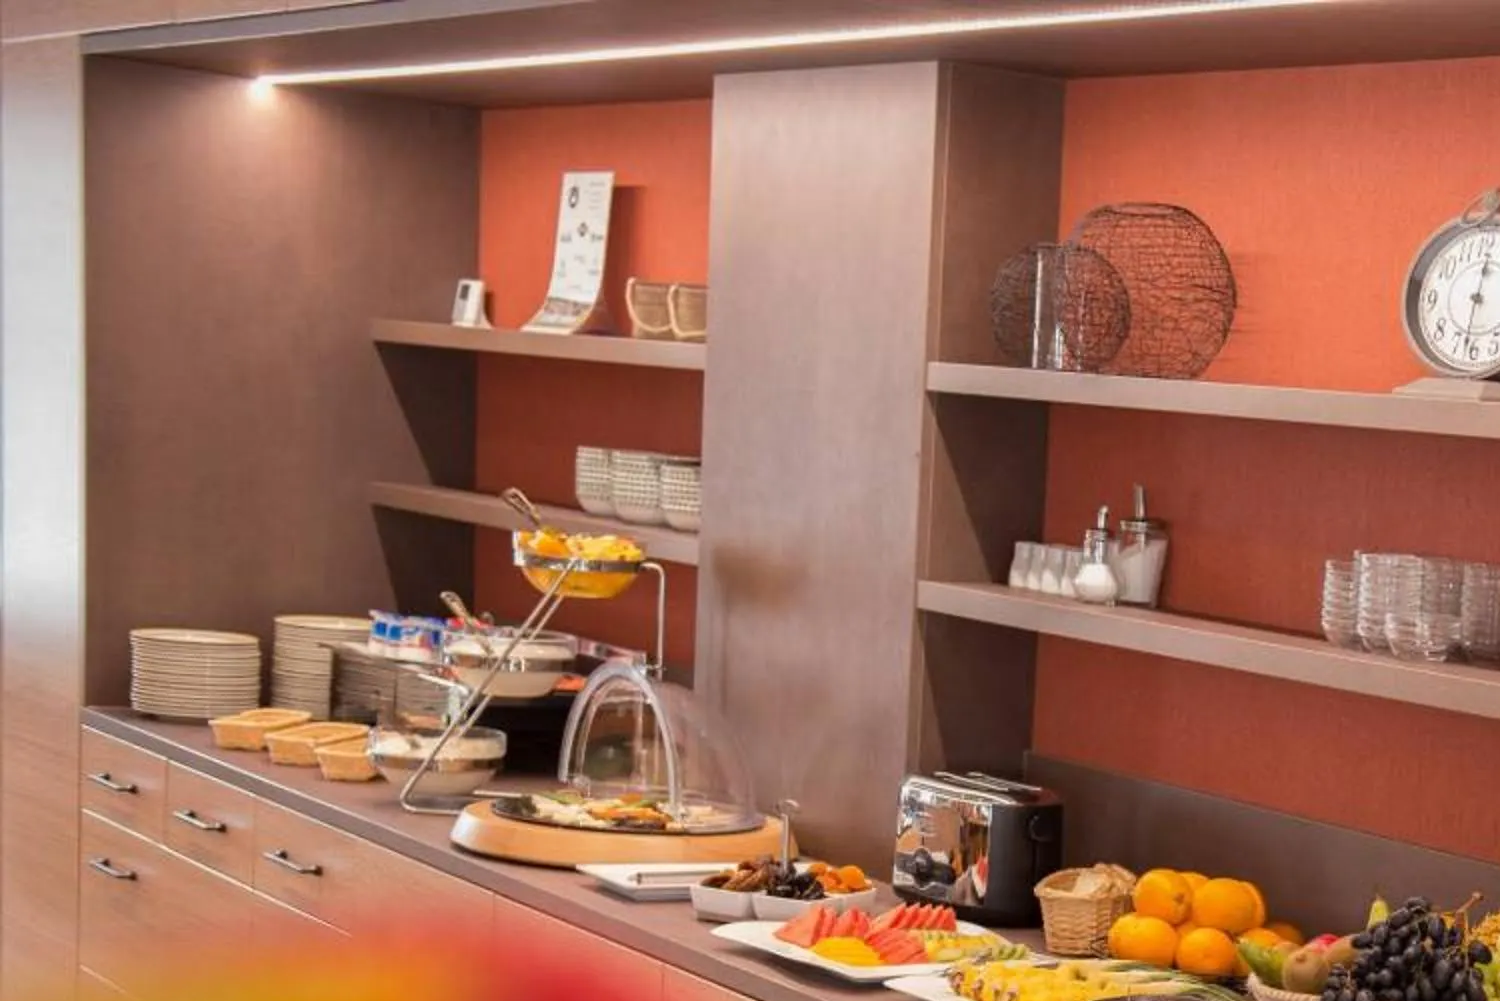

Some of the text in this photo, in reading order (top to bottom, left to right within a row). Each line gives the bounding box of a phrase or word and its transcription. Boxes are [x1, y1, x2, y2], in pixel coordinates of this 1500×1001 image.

[1459, 240, 1475, 262] 11
[1478, 232, 1496, 257] 12
[1438, 255, 1457, 280] 10
[1427, 287, 1438, 313] 9
[1434, 317, 1446, 341] 8
[1451, 331, 1463, 355] 7
[1469, 338, 1479, 361] 6
[1487, 330, 1500, 357] 5
